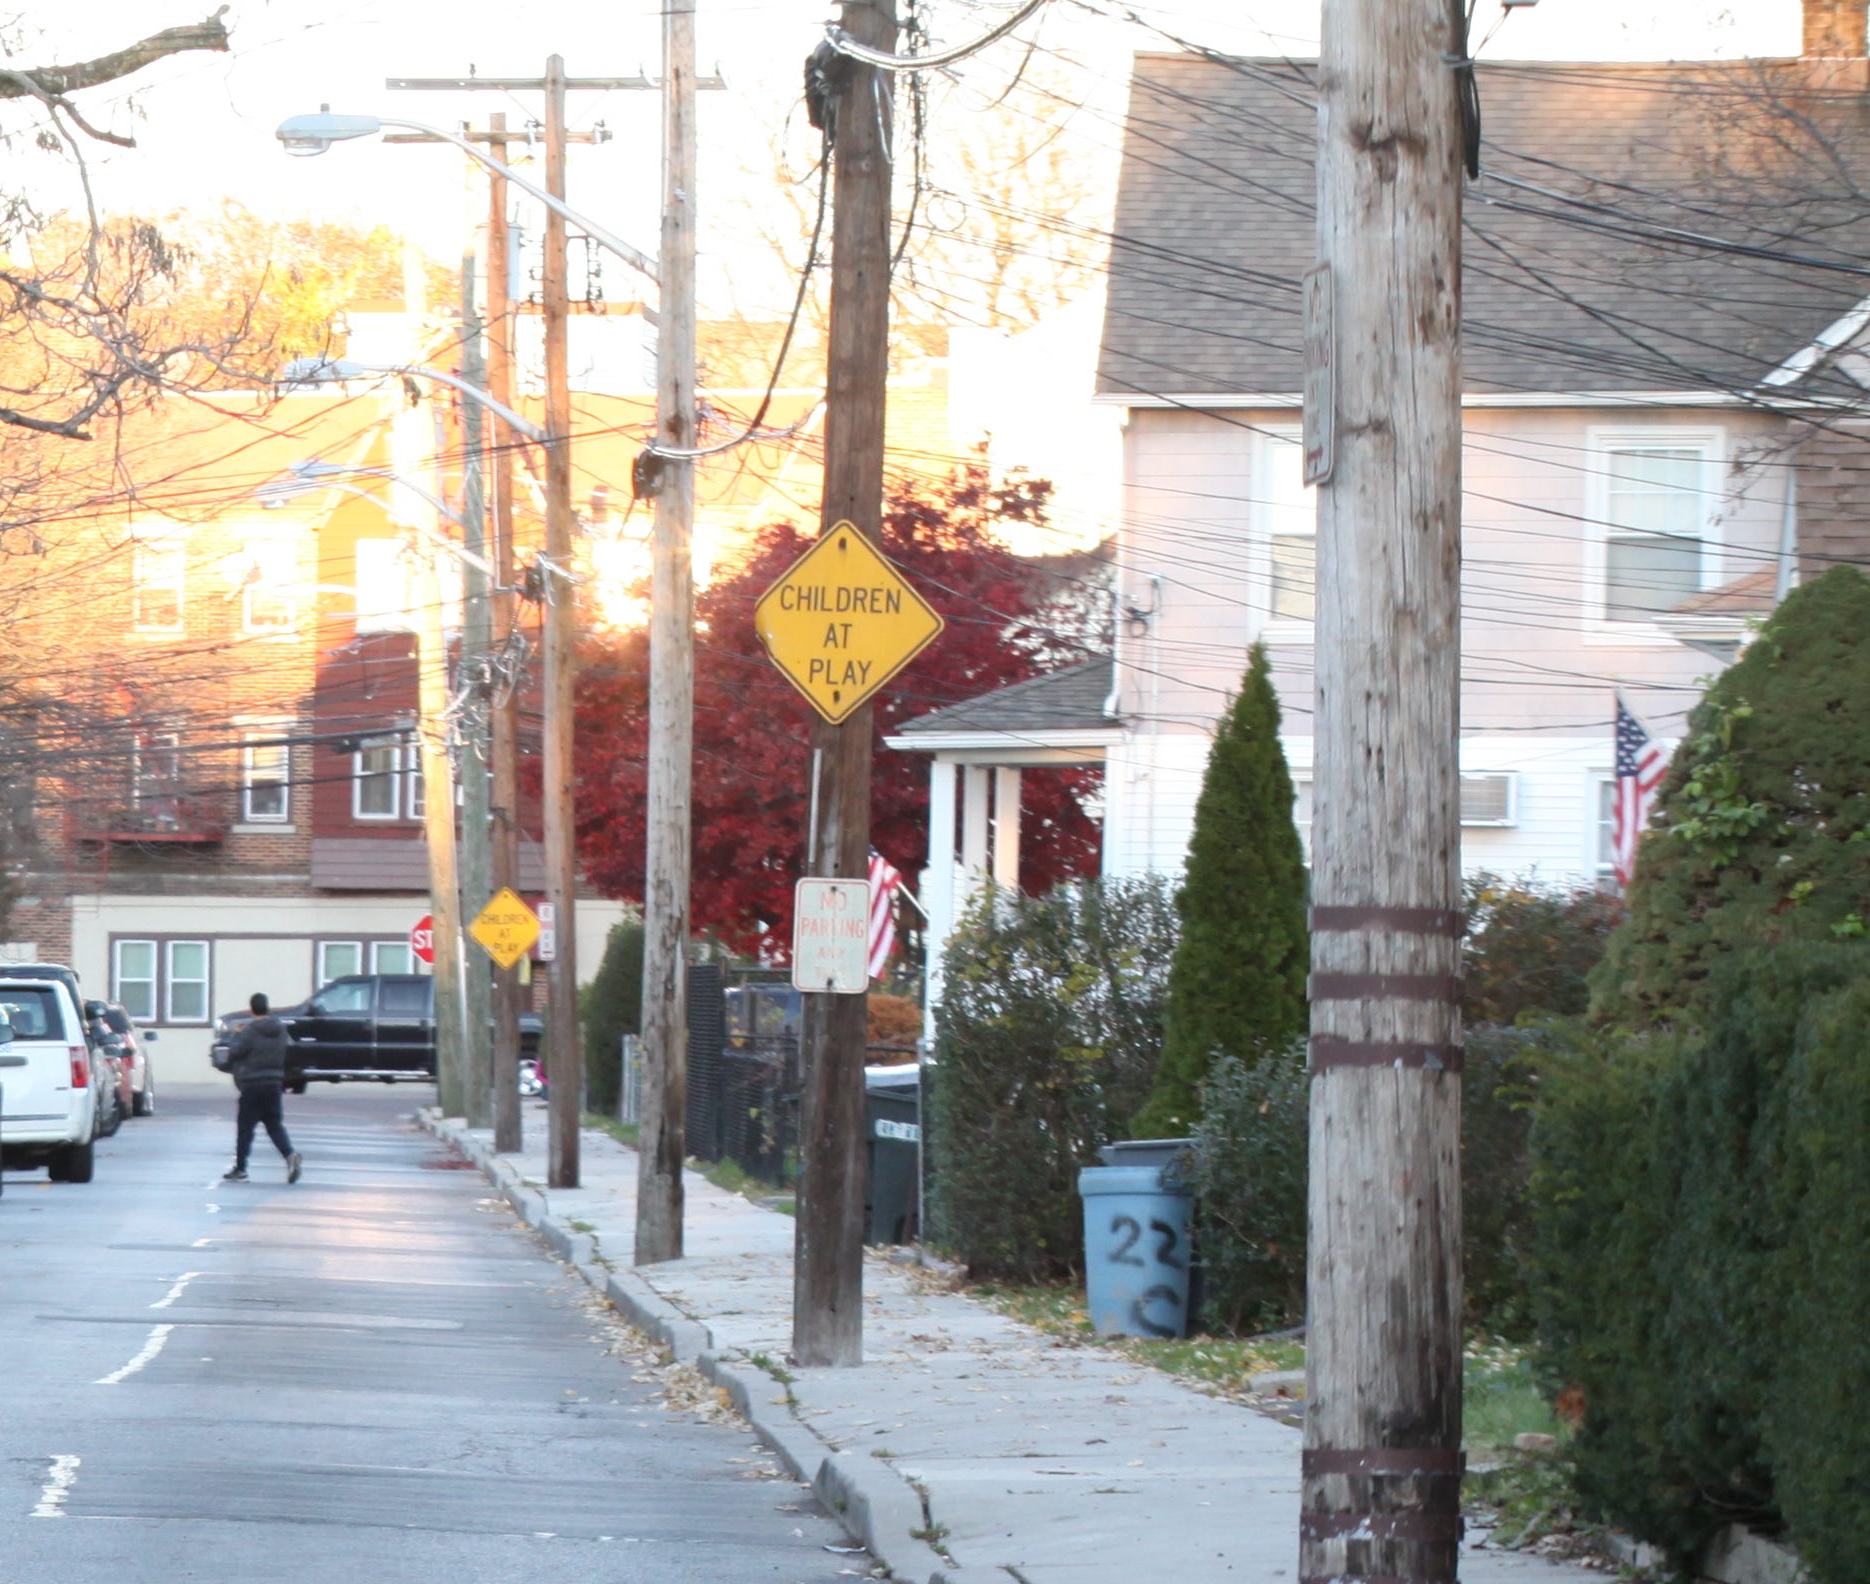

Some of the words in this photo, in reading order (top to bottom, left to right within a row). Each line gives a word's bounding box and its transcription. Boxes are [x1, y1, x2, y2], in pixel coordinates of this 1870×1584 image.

[780, 585, 901, 614] CHILDREN
[823, 623, 852, 649] AT
[809, 658, 872, 685] PLAY
[820, 891, 847, 912] NO
[482, 913, 530, 925] CHILDREN
[499, 927, 510, 938] AT
[494, 942, 518, 953] PLAY
[1107, 1216, 1183, 1270] 22
